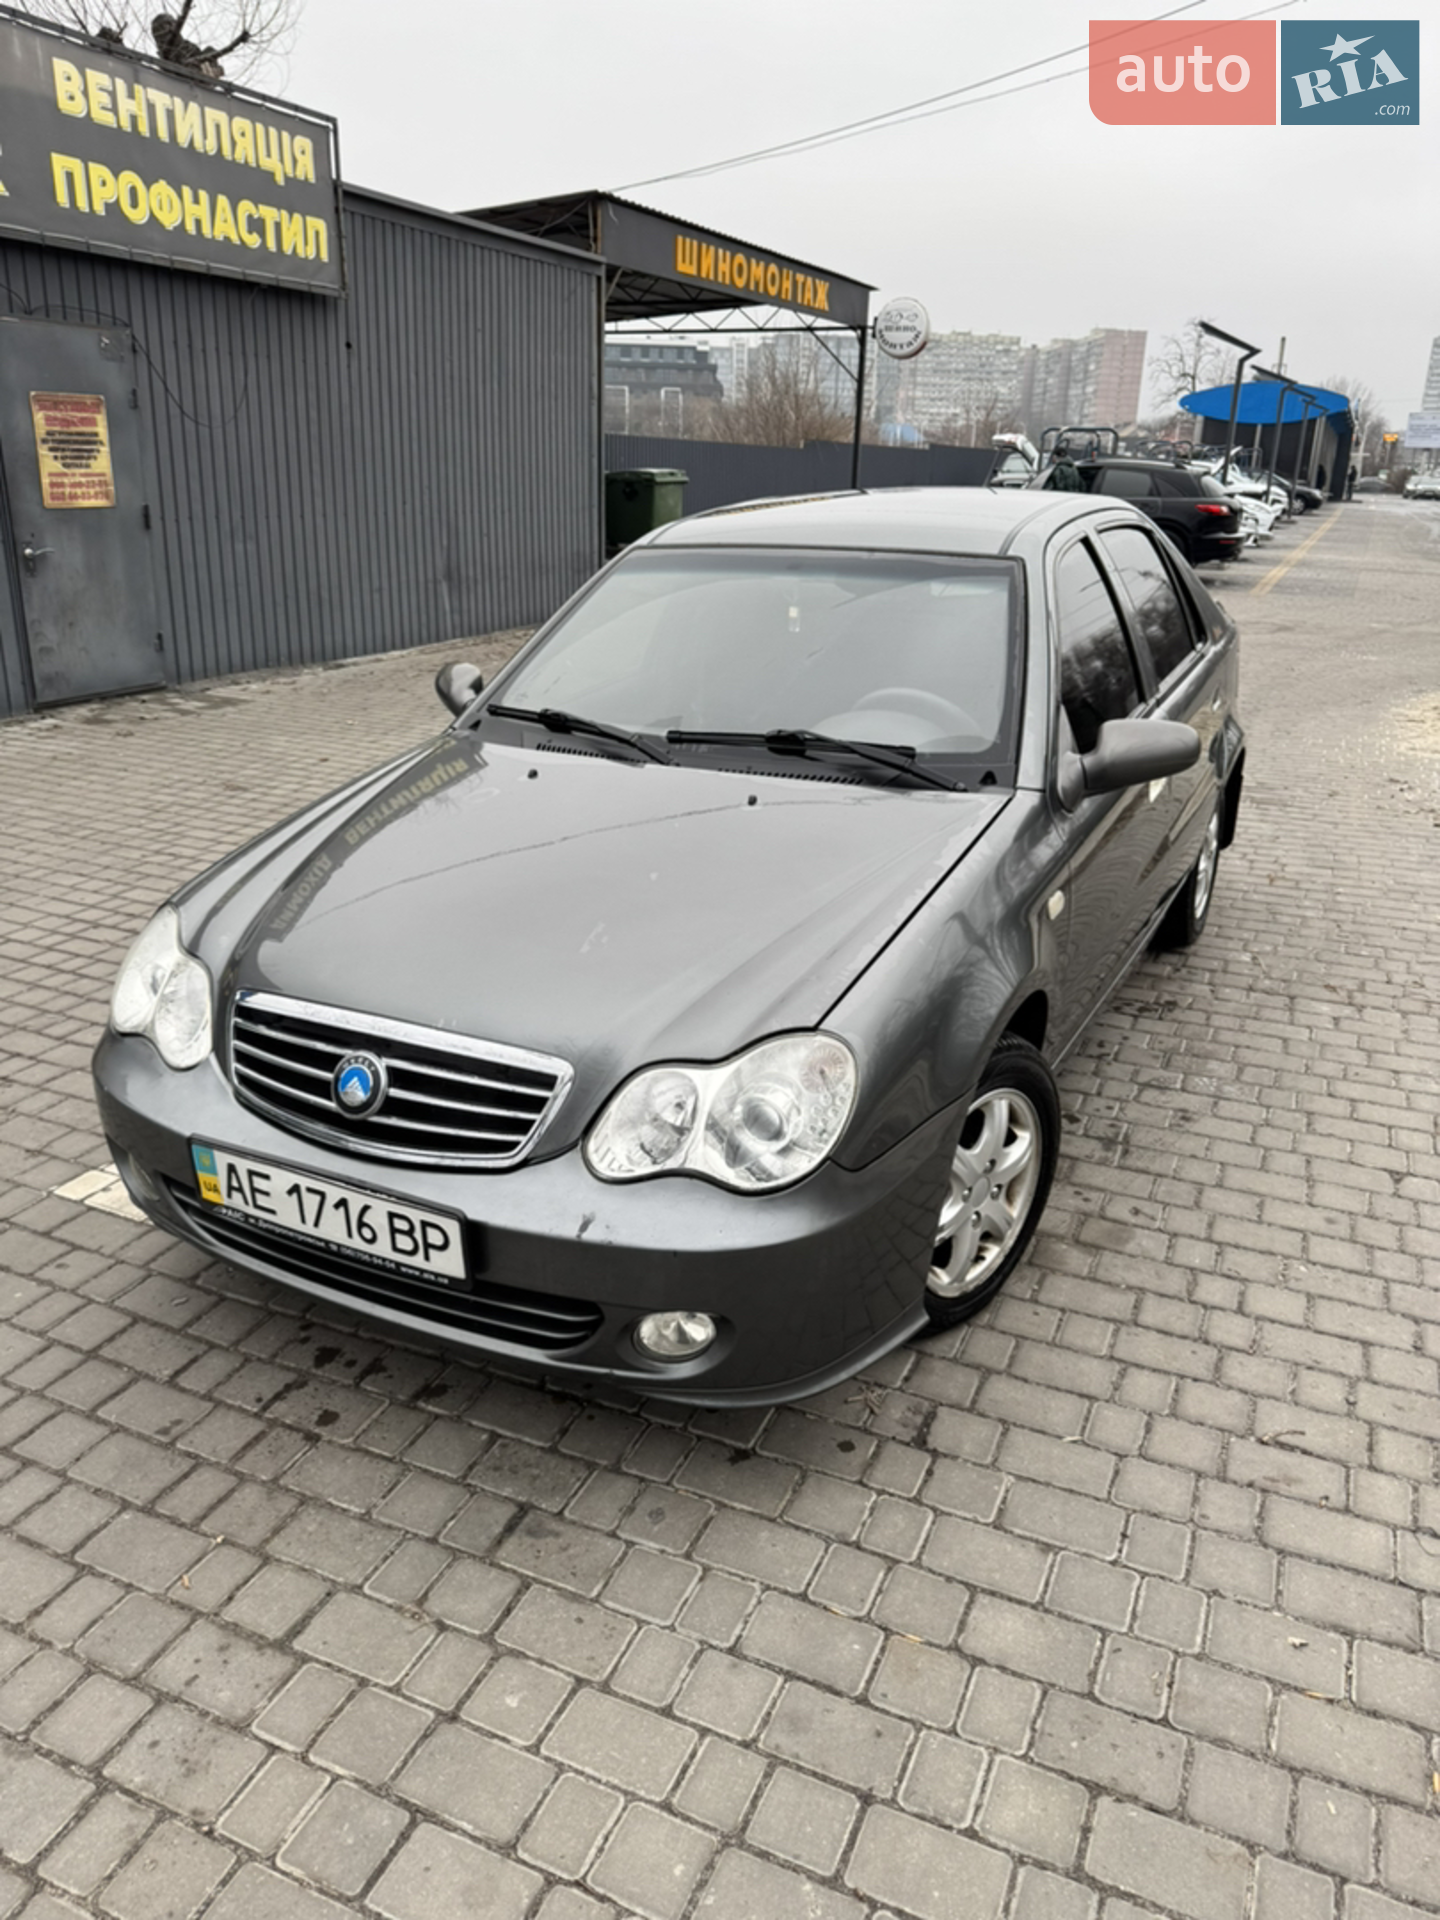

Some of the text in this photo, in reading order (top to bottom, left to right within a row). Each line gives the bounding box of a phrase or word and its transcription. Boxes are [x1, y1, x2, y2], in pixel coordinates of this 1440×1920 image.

[52, 56, 316, 186] ВЕНТИЛЯЦІЯ
[50, 152, 329, 263] ПРОФНАСТИЛ
[676, 235, 830, 312] ШИНОМОНТАЖ
[203, 1180, 220, 1195] UA
[226, 1162, 278, 1216] AE
[286, 1182, 378, 1245] 1716
[386, 1210, 451, 1262] BP
